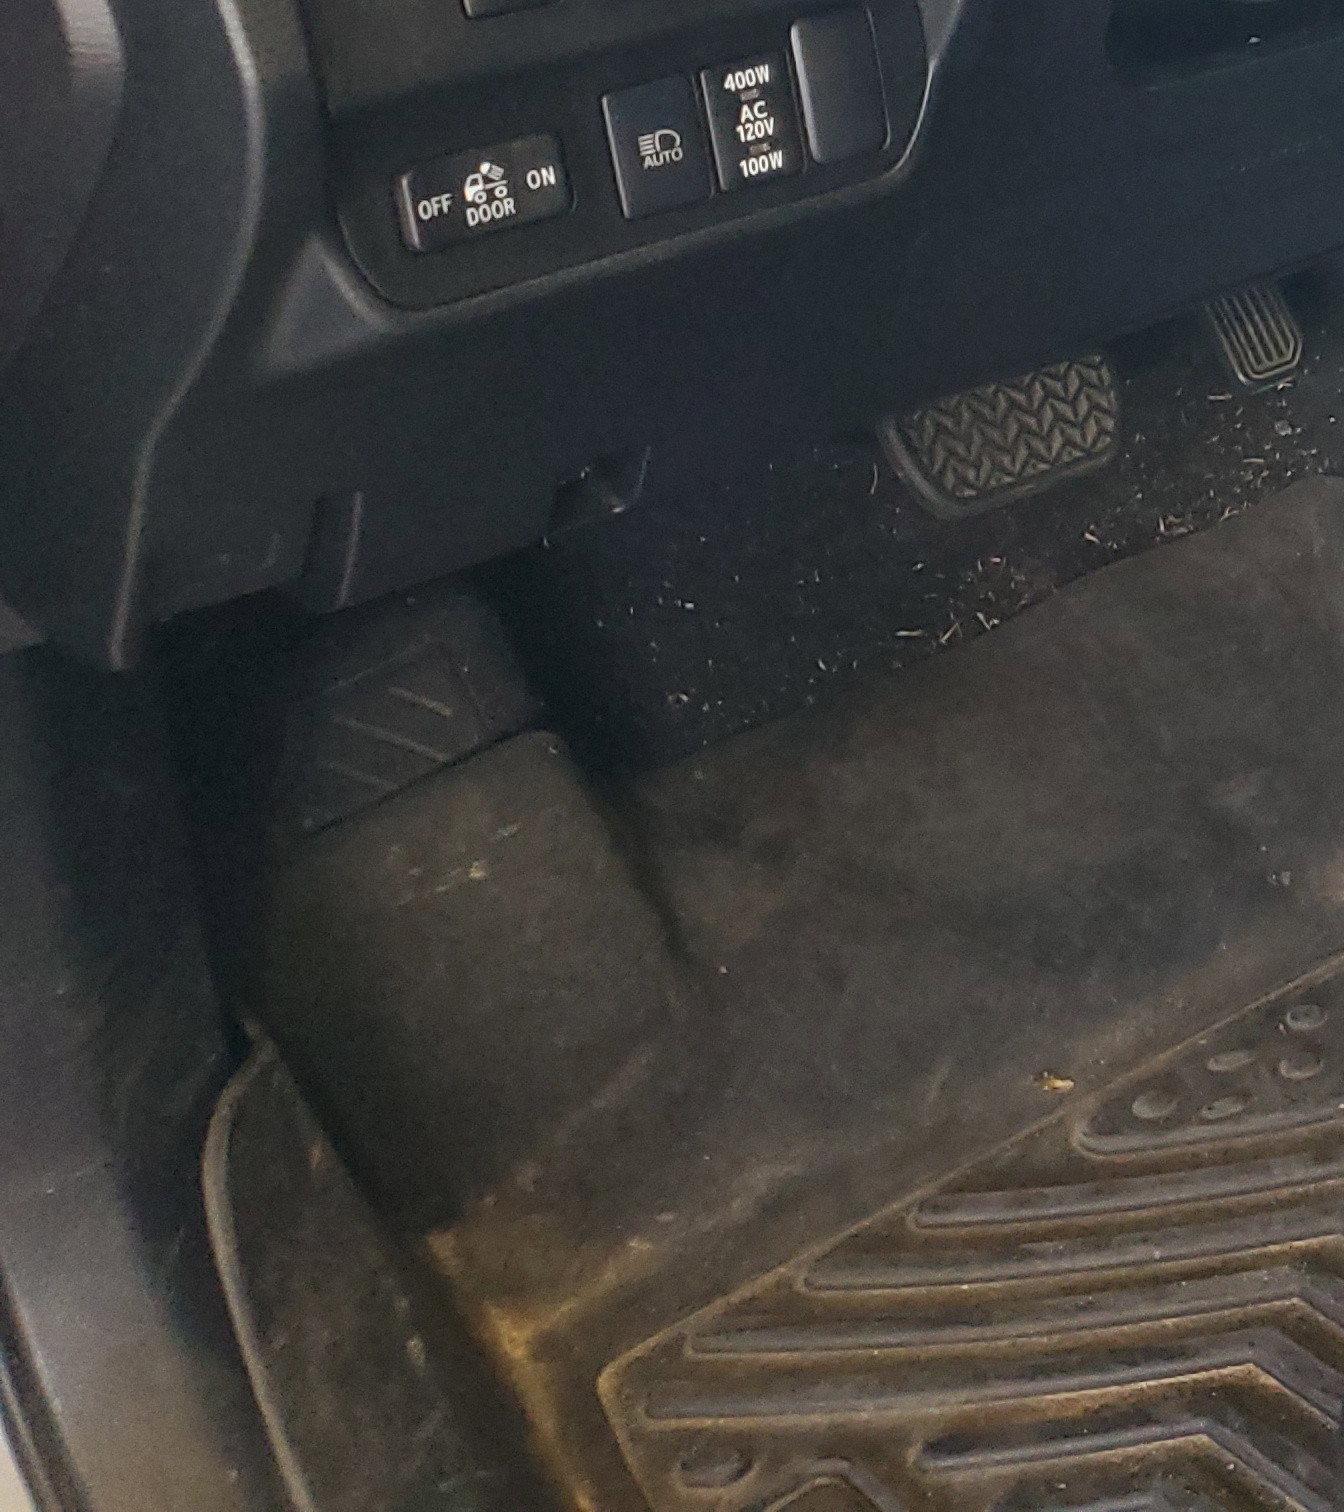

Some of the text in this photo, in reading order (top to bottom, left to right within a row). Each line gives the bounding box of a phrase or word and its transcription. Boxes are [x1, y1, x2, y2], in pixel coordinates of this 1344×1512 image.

[723, 63, 771, 92] 400W
[740, 100, 769, 122] AC
[735, 117, 775, 143] 120V
[643, 146, 684, 170] AUTO
[738, 150, 784, 179] 100W
[417, 165, 557, 221] OFF ON
[465, 197, 517, 228] DOOR
